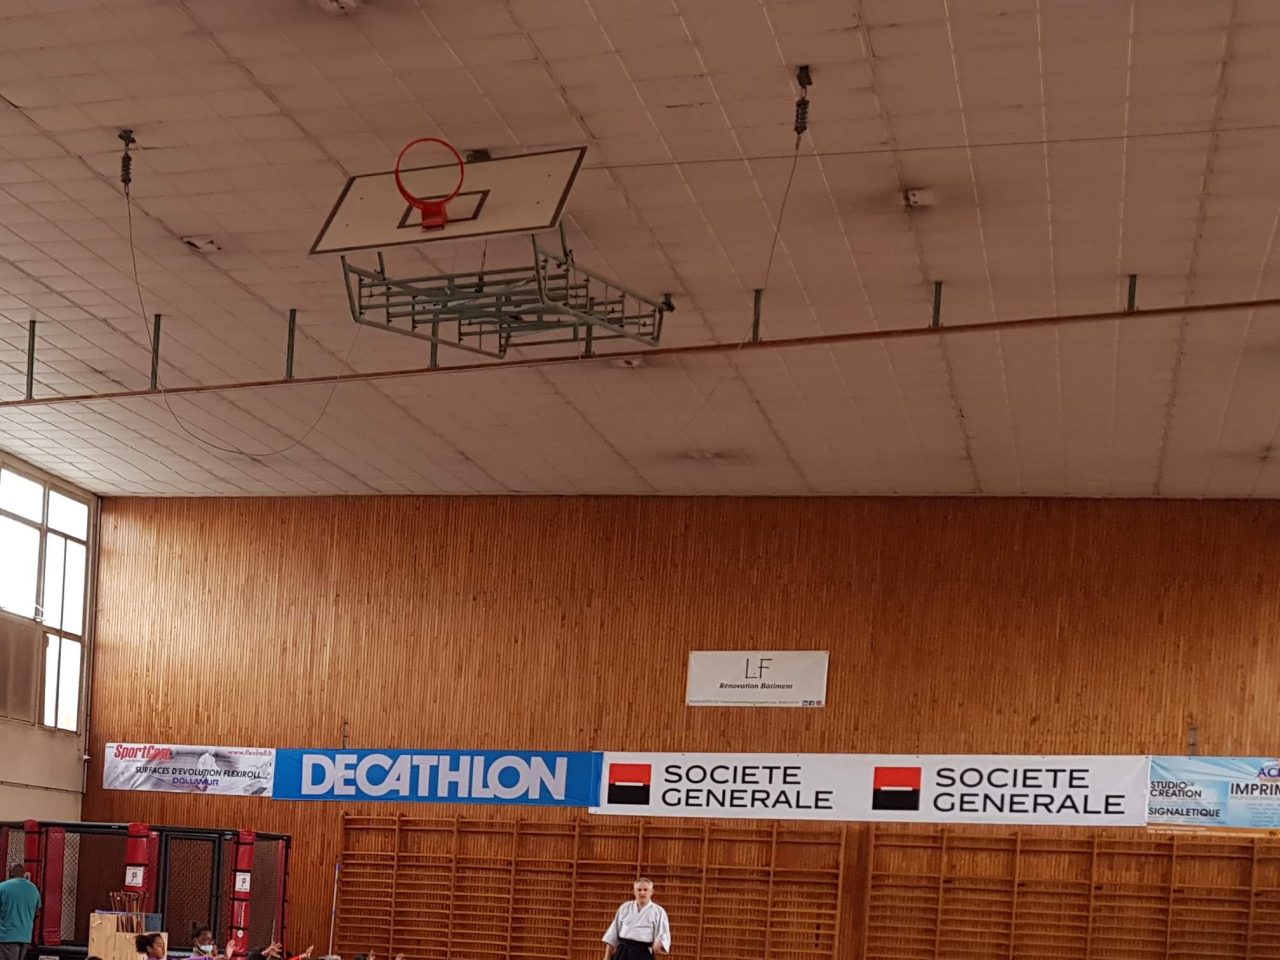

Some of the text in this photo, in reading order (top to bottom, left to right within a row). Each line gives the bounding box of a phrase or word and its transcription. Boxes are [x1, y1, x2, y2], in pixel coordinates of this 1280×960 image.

[135, 766, 170, 775] SURFACES
[301, 753, 568, 800] DECATHLON
[664, 765, 802, 785] SOCIETE
[935, 768, 1090, 788] SOCIETE
[172, 777, 219, 787] DOLLAMUR
[1150, 780, 1187, 790] STUDIO
[661, 788, 833, 809] GENERALE
[1149, 789, 1202, 798] CREATION
[933, 792, 1126, 815] GENERALE
[1148, 807, 1221, 818] SIGNALETIQUE
